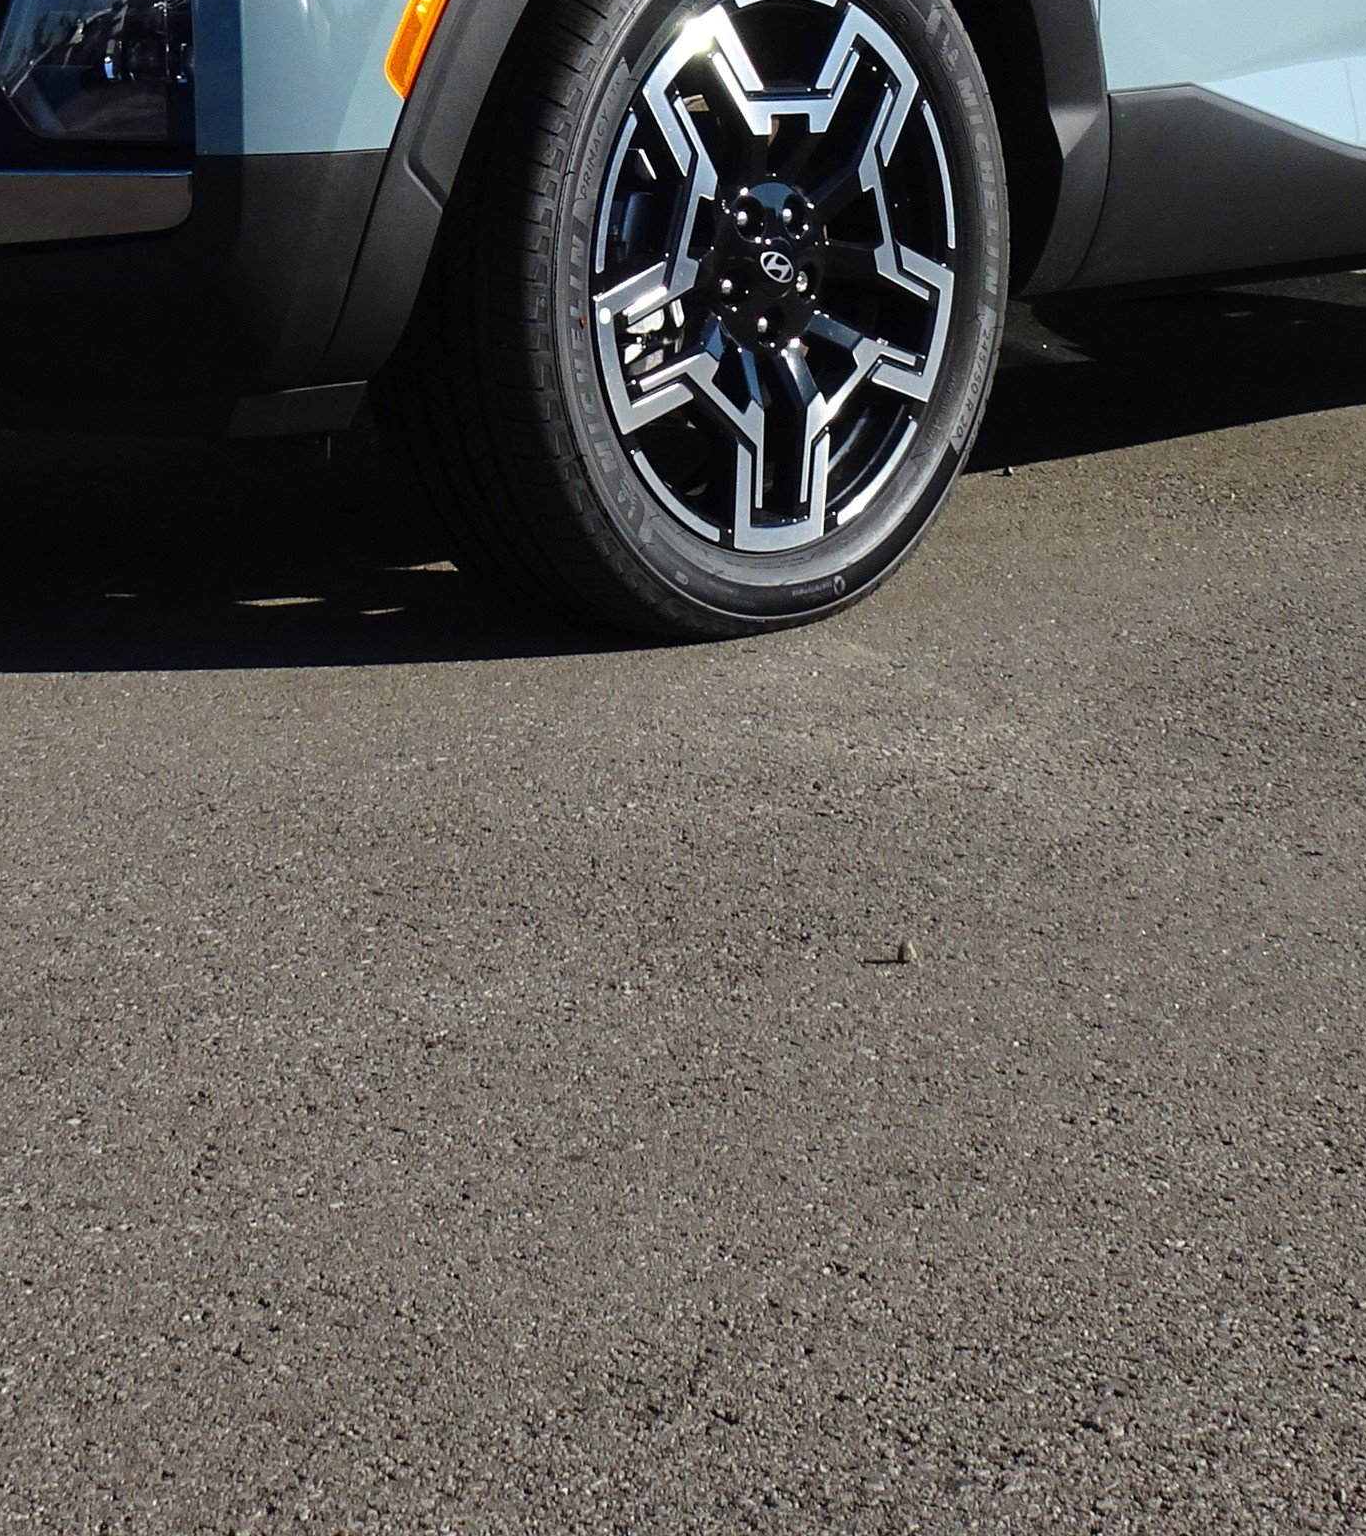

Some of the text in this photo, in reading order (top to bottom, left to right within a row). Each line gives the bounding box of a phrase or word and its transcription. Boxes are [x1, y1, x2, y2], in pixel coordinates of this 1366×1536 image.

[580, 109, 610, 199] PRIMACY
[956, 75, 1000, 295] MICHELIN
[569, 234, 619, 473] MICHELIN
